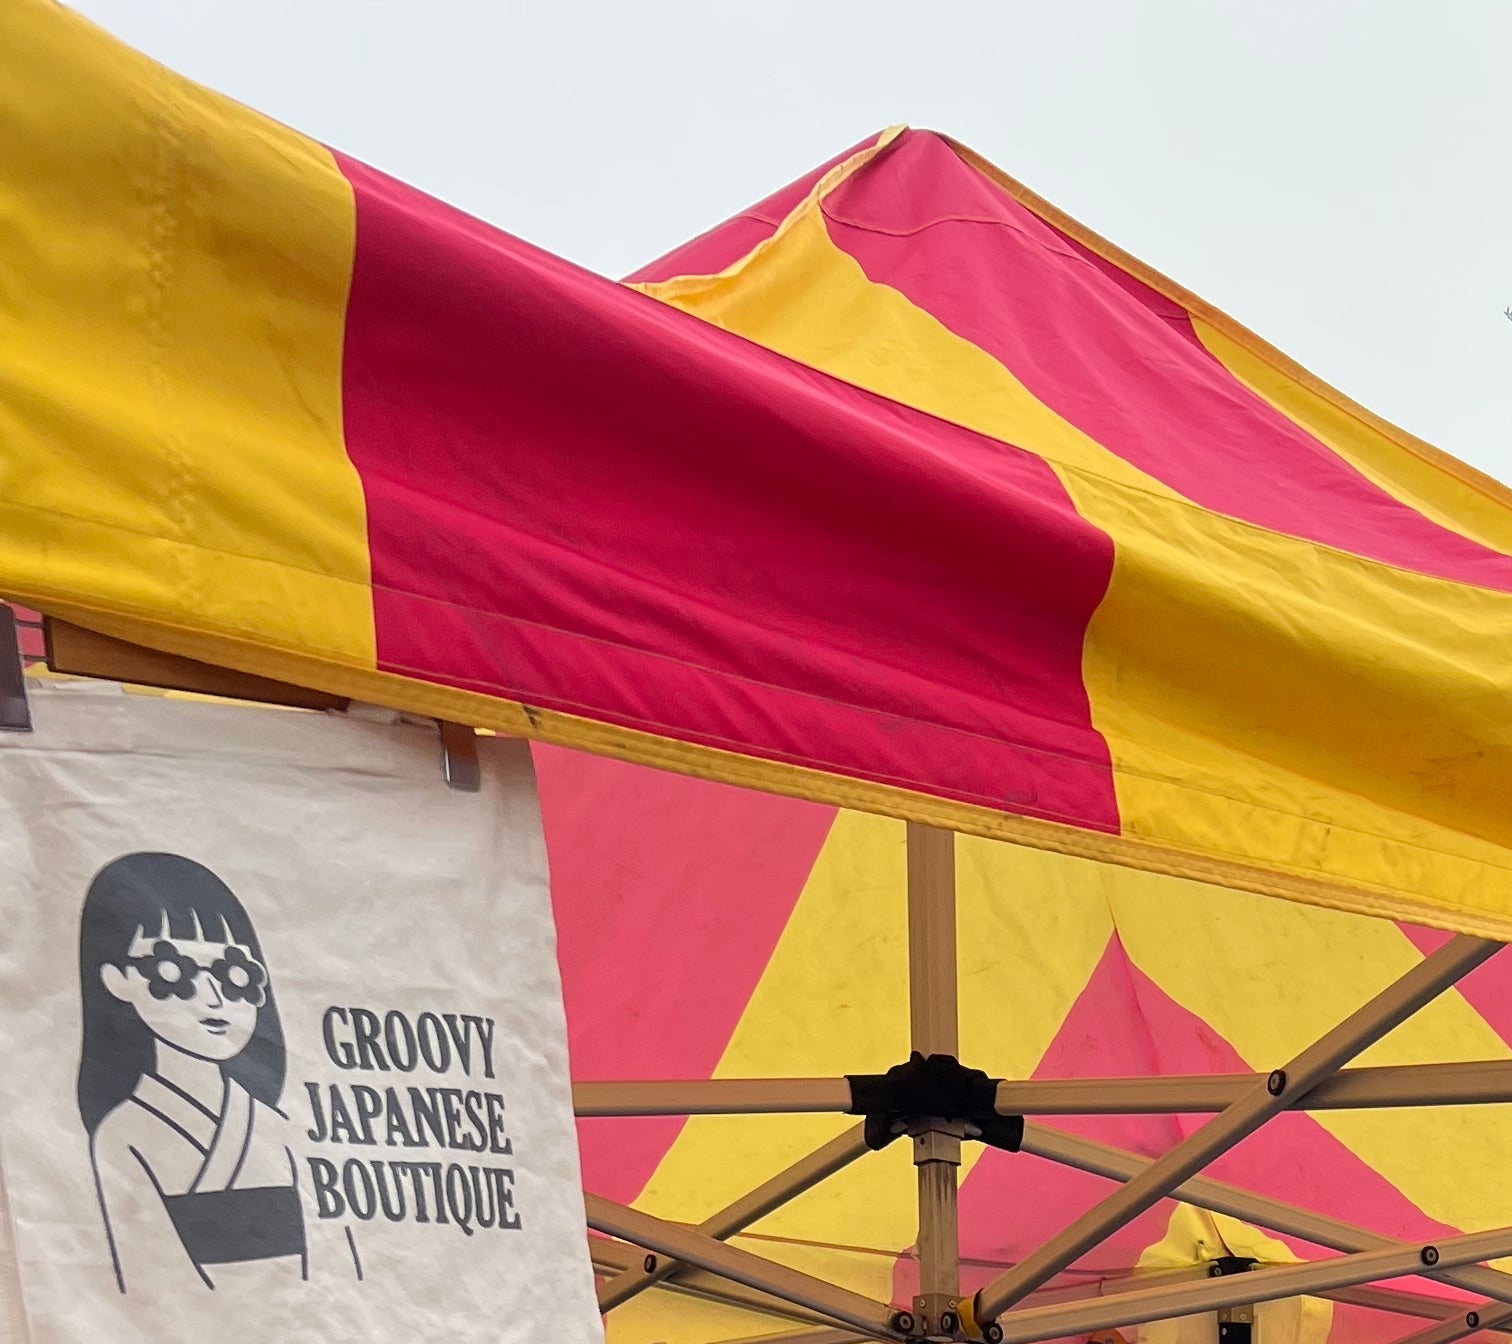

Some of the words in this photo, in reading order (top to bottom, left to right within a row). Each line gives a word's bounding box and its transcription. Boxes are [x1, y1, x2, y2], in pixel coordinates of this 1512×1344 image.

[323, 1006, 496, 1079] GROOVY
[304, 1082, 514, 1156] JAPANESE
[307, 1157, 523, 1237] BOUTIQUE
